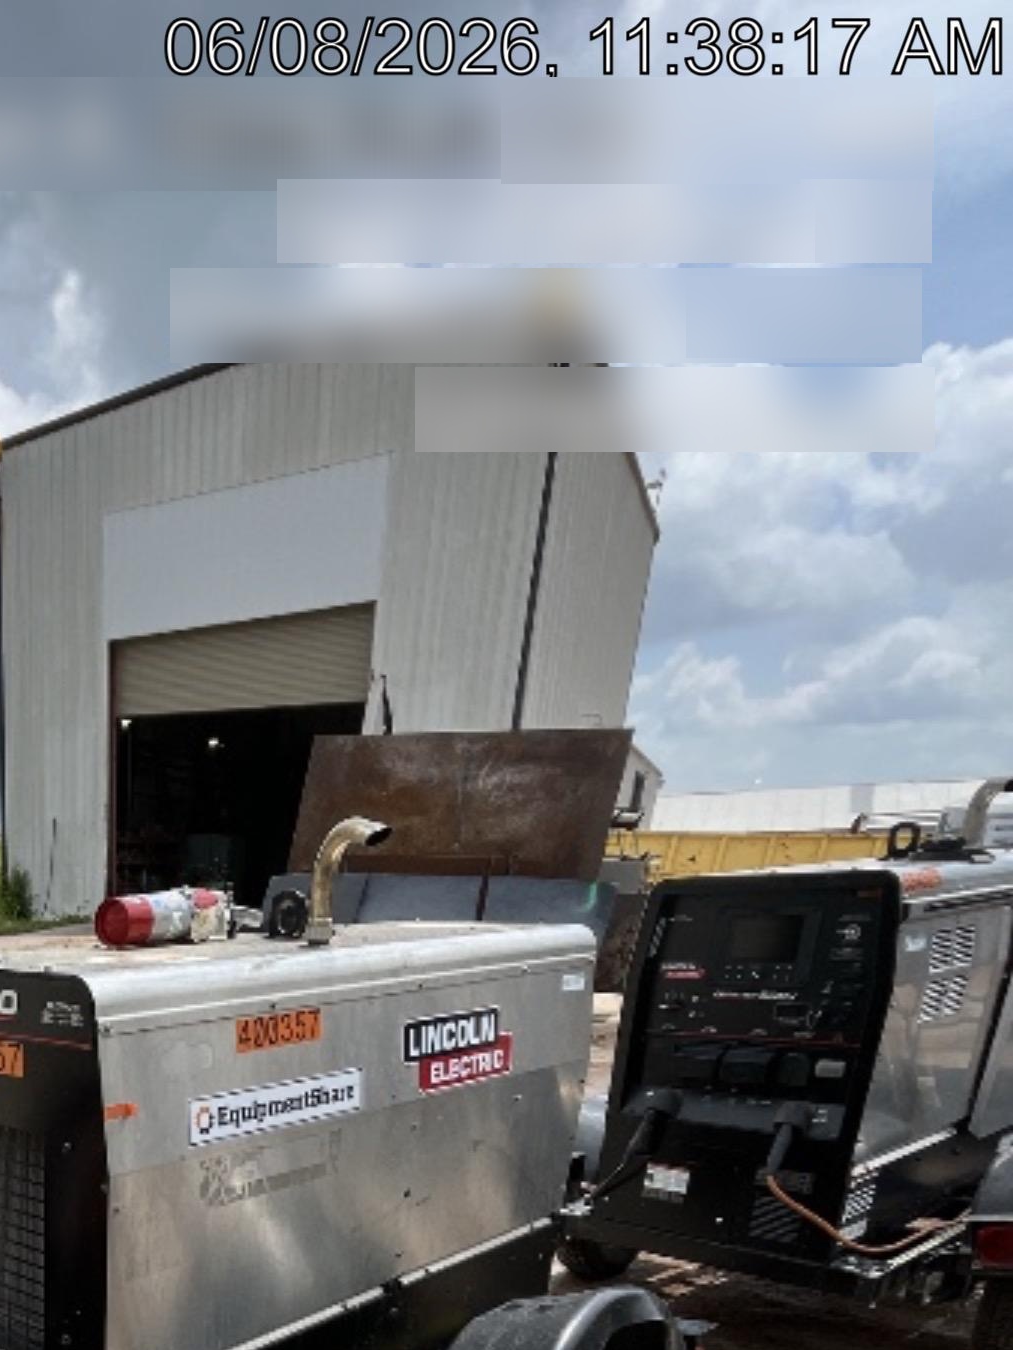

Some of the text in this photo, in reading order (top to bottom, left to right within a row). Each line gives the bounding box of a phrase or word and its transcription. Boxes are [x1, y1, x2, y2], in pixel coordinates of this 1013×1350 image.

[238, 1008, 321, 1047] 400357
[408, 1012, 496, 1057] LINCOLN
[429, 1049, 504, 1084] ELECTRIC
[217, 1085, 355, 1128] EquipmentShare
